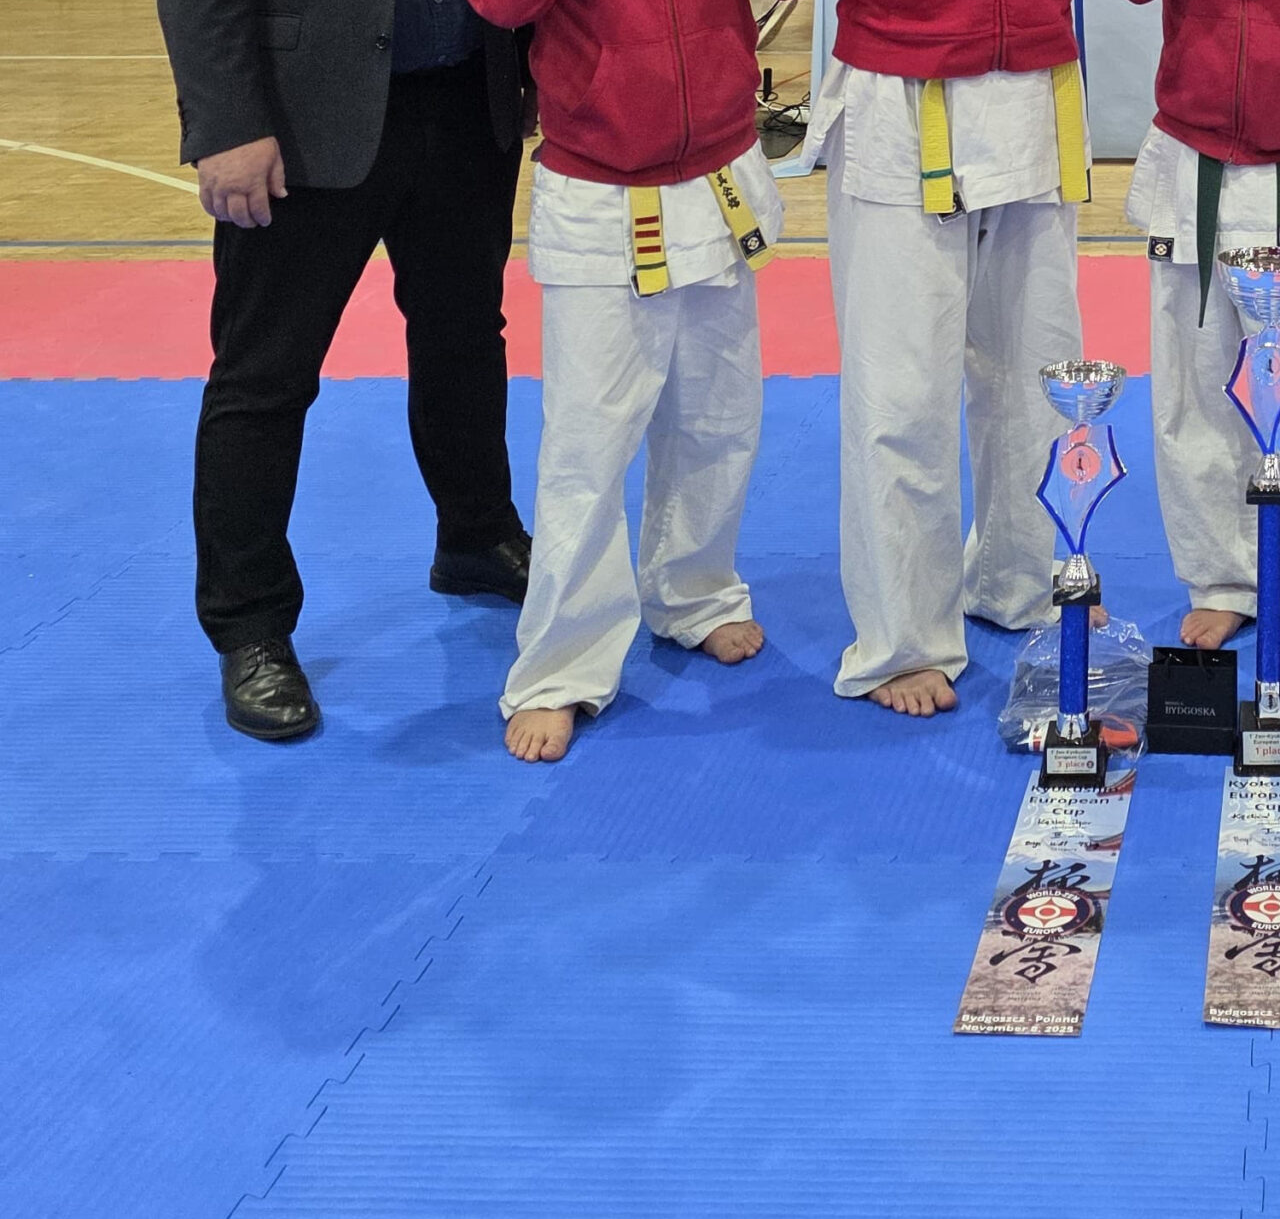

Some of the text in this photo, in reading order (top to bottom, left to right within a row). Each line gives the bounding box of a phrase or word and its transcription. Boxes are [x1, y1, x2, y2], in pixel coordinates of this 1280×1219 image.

[1164, 706, 1216, 717] BYDGOSKA
[1029, 796, 1110, 806] European
[1051, 807, 1086, 818] Cup
[1022, 926, 1065, 936] EUROPE
[1209, 1007, 1274, 1018] Bydgoszcz
[961, 1013, 1079, 1024] Bydgoszcz Poland
[1210, 1016, 1279, 1026] November
[960, 1024, 1029, 1033] November
[1043, 1025, 1074, 1033] 2025
